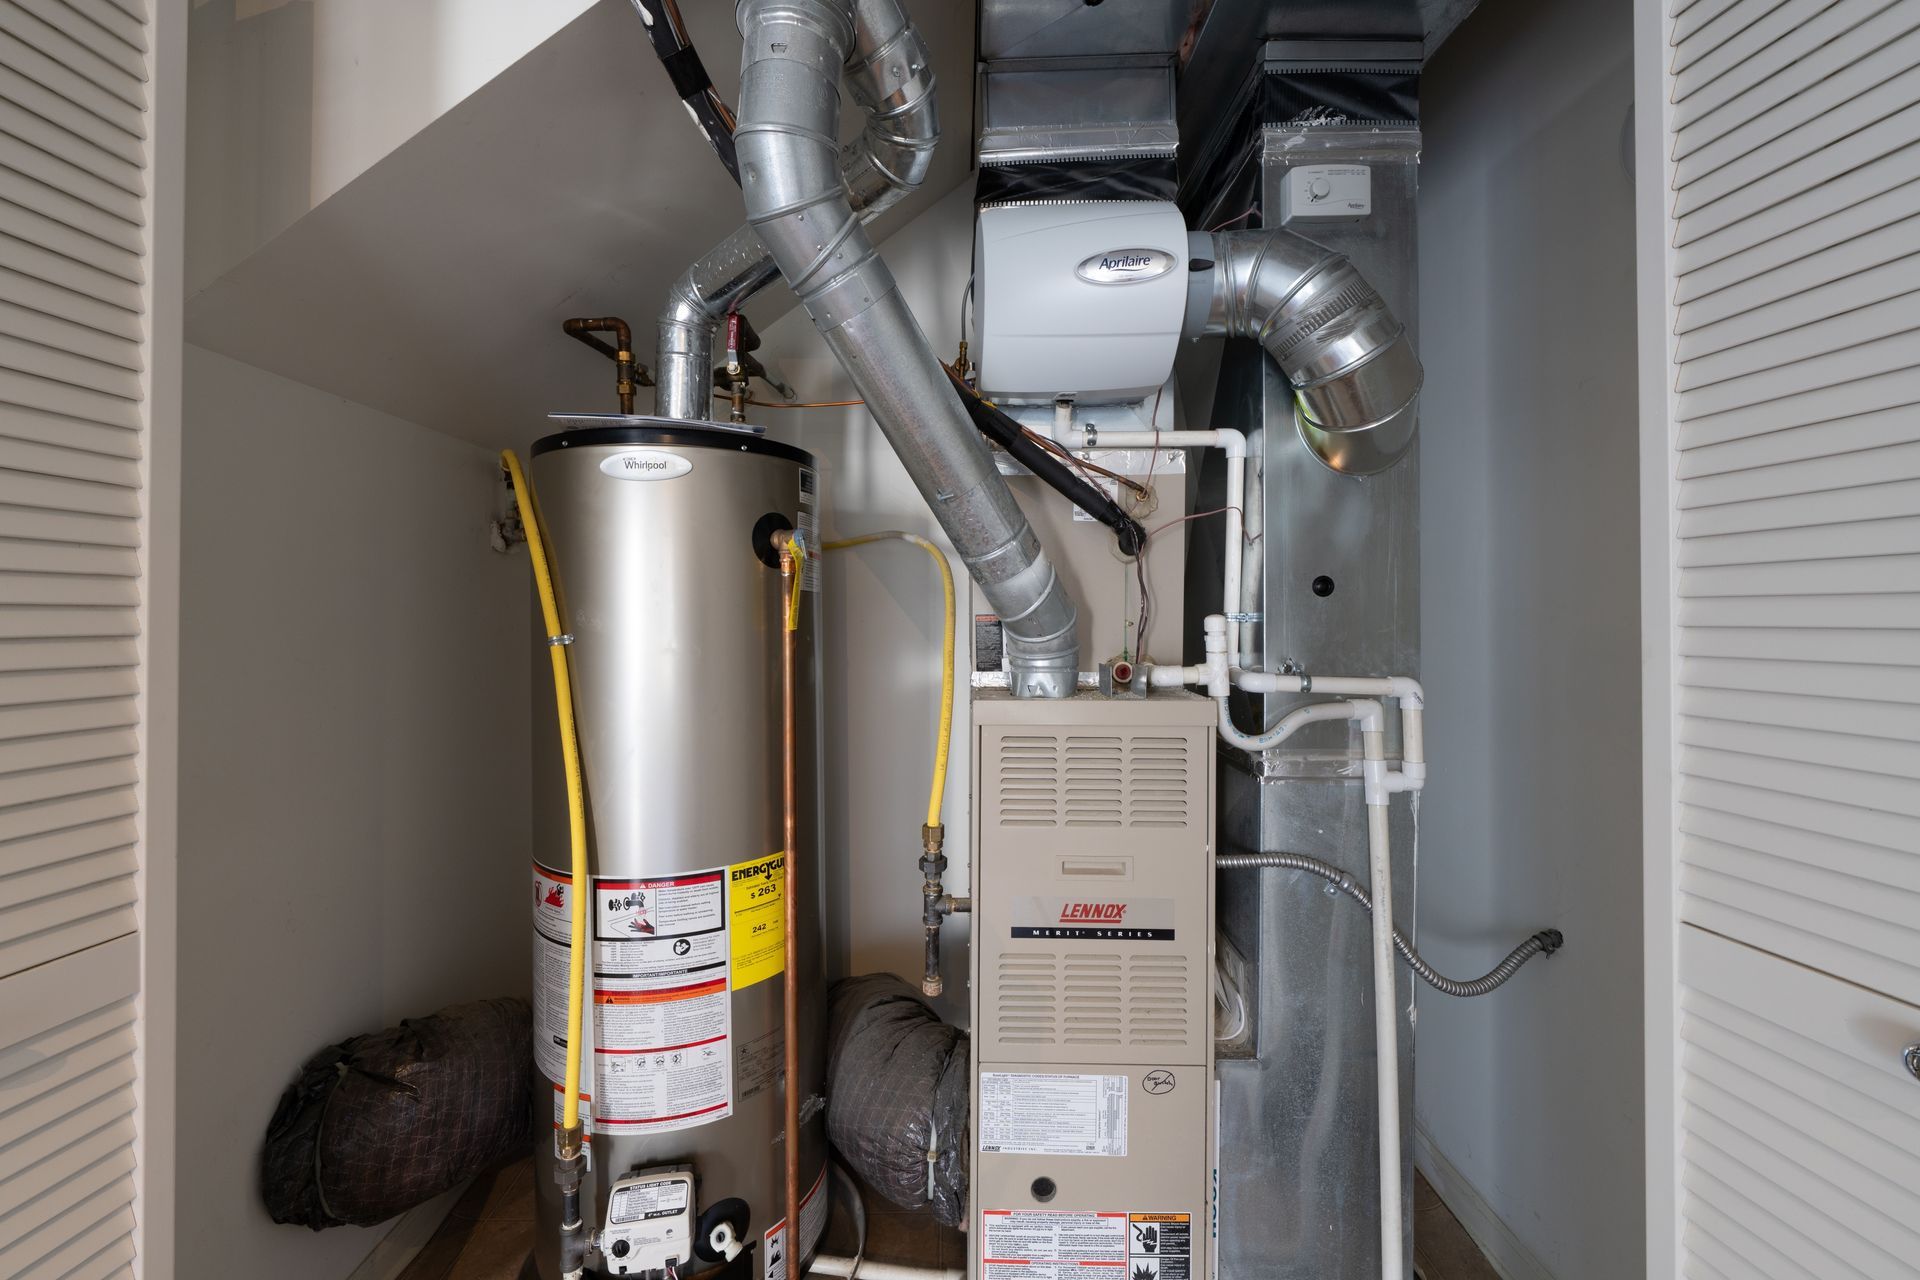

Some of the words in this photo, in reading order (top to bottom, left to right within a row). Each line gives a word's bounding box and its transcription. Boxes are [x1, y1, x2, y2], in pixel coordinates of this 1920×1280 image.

[1099, 255, 1151, 270] Aprilaire
[624, 461, 667, 471] Whirlpool
[648, 881, 675, 889] DANGER
[758, 884, 776, 897] 263
[1061, 903, 1127, 919] LENNOX
[753, 923, 767, 933] 242
